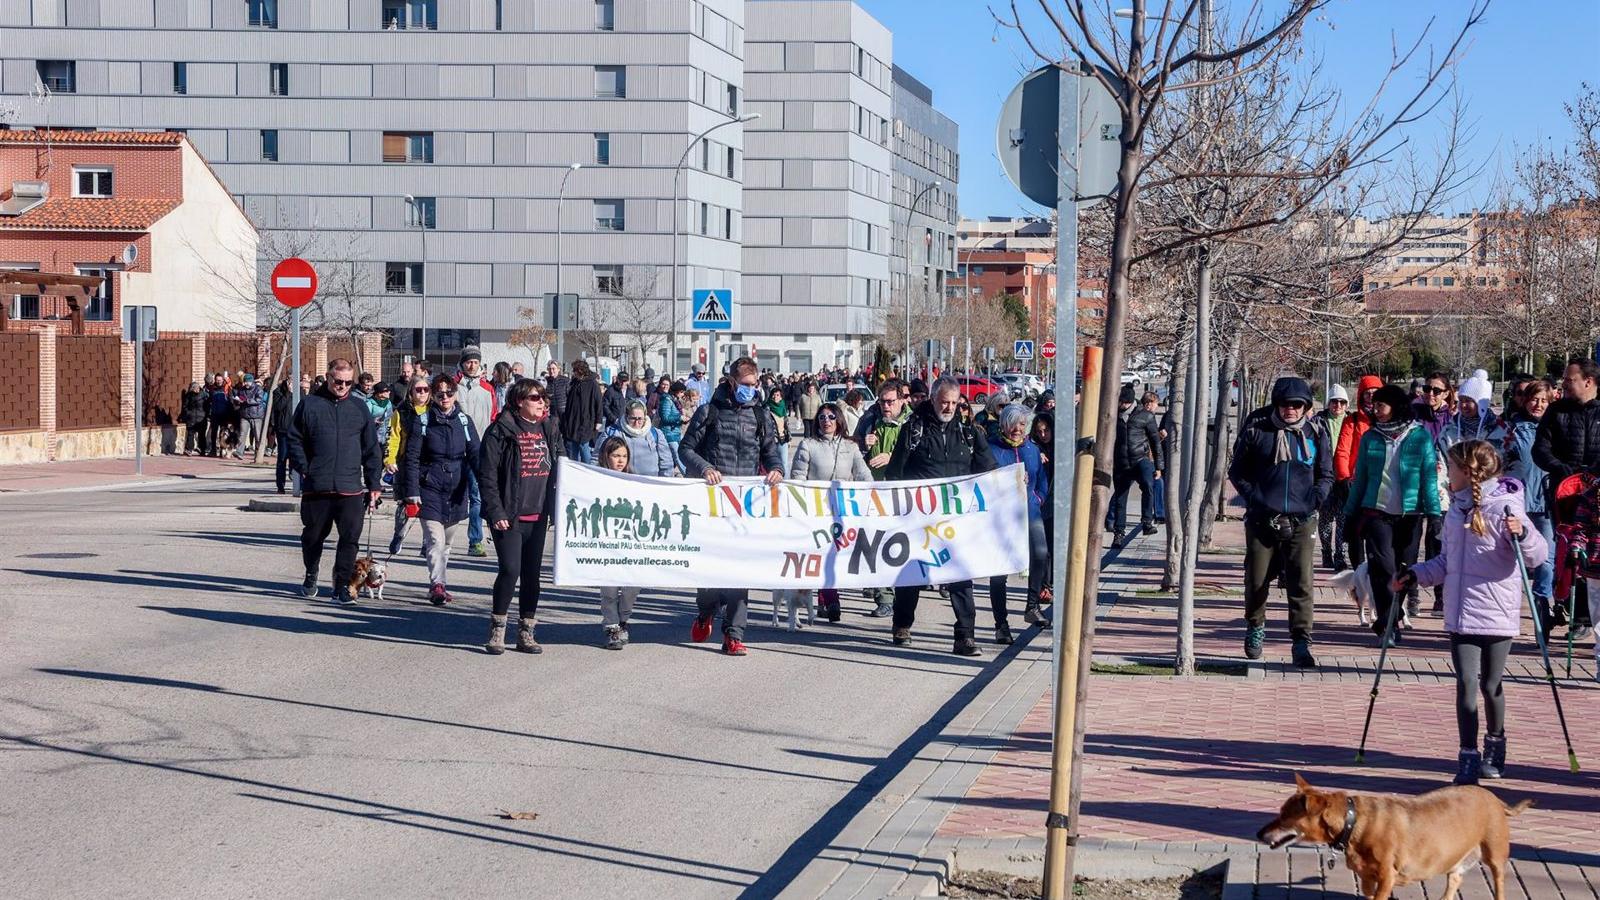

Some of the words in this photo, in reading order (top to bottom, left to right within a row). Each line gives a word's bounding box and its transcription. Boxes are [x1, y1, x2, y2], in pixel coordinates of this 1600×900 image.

[707, 482, 988, 517] INCINERADORA
[606, 516, 655, 542] PAU
[565, 540, 598, 549] Asociación
[599, 541, 619, 550] Vecinal
[620, 542, 632, 550] PAU
[634, 542, 642, 550] del
[677, 544, 701, 552] Vallecas
[848, 527, 910, 575] NO
[576, 556, 690, 568] www.paudevallecas.org
